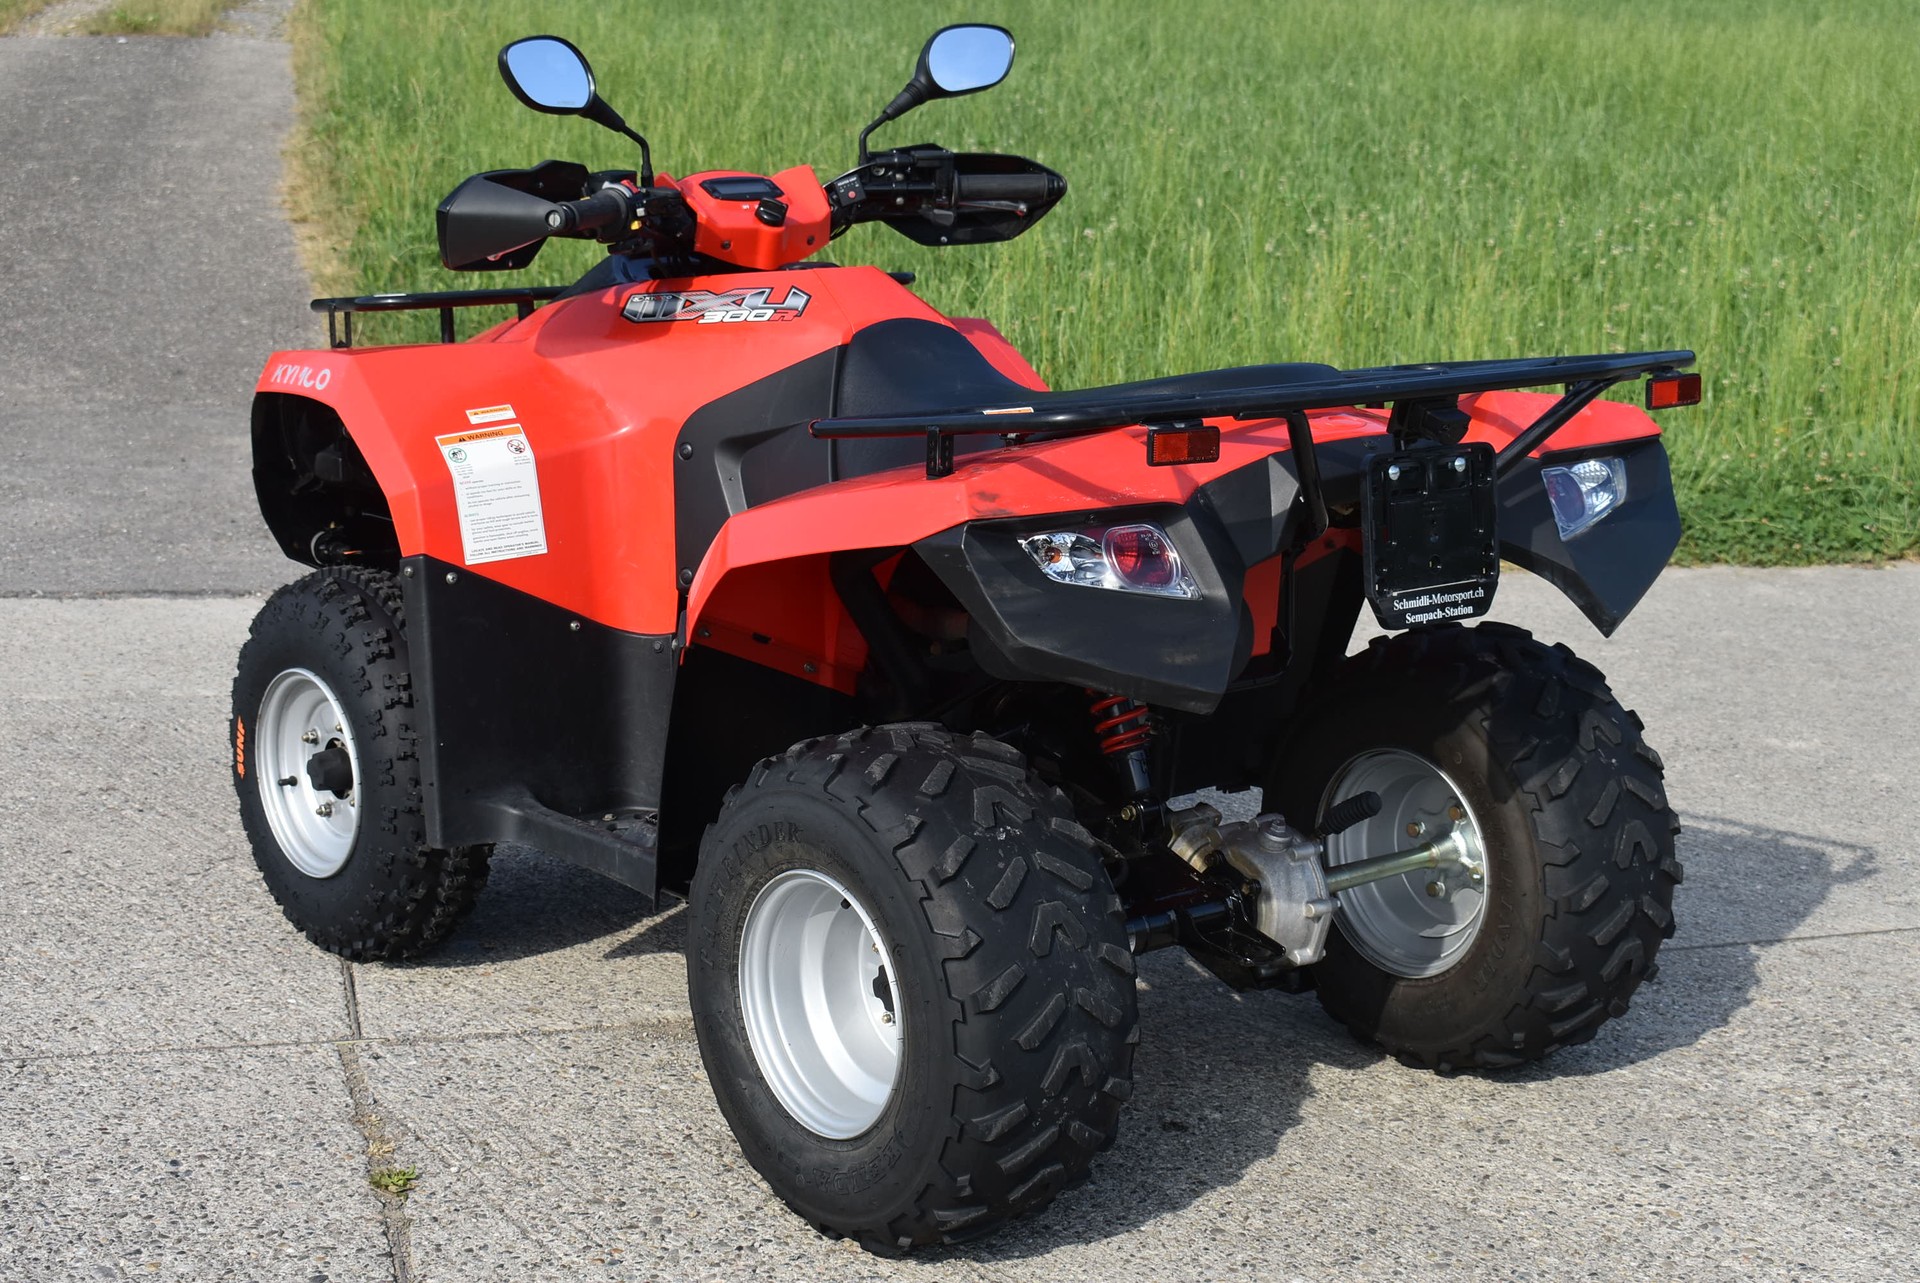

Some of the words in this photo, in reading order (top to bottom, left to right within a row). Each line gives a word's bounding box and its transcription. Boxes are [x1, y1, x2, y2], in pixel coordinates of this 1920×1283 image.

[698, 308, 801, 324] 300R
[467, 430, 504, 441] WARNING
[1393, 587, 1484, 611] Schmidli-Motorsport.ch
[1405, 605, 1473, 624] Sempach-Station
